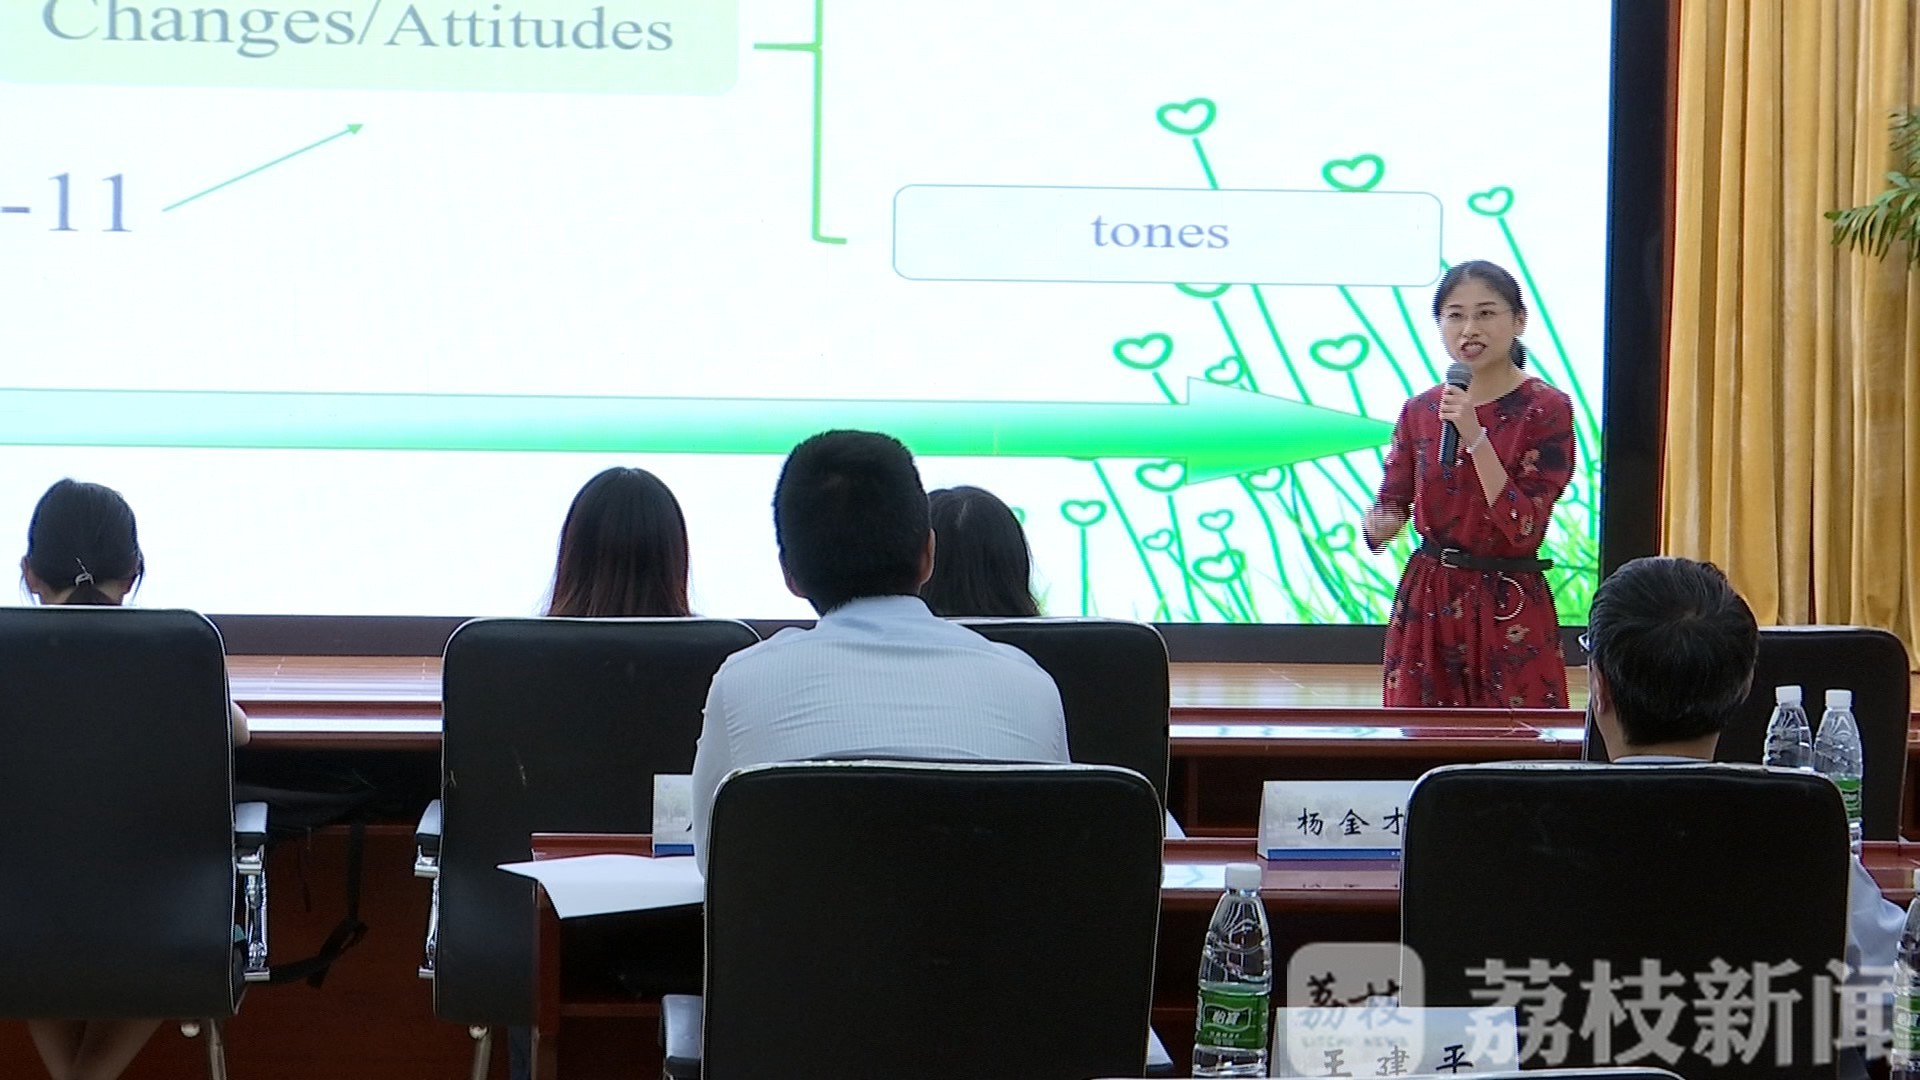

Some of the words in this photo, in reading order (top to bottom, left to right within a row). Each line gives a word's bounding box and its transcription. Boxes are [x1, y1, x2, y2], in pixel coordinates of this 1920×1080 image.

[1091, 215, 1230, 249] tones
[1320, 1044, 1474, 1077] 王建平
